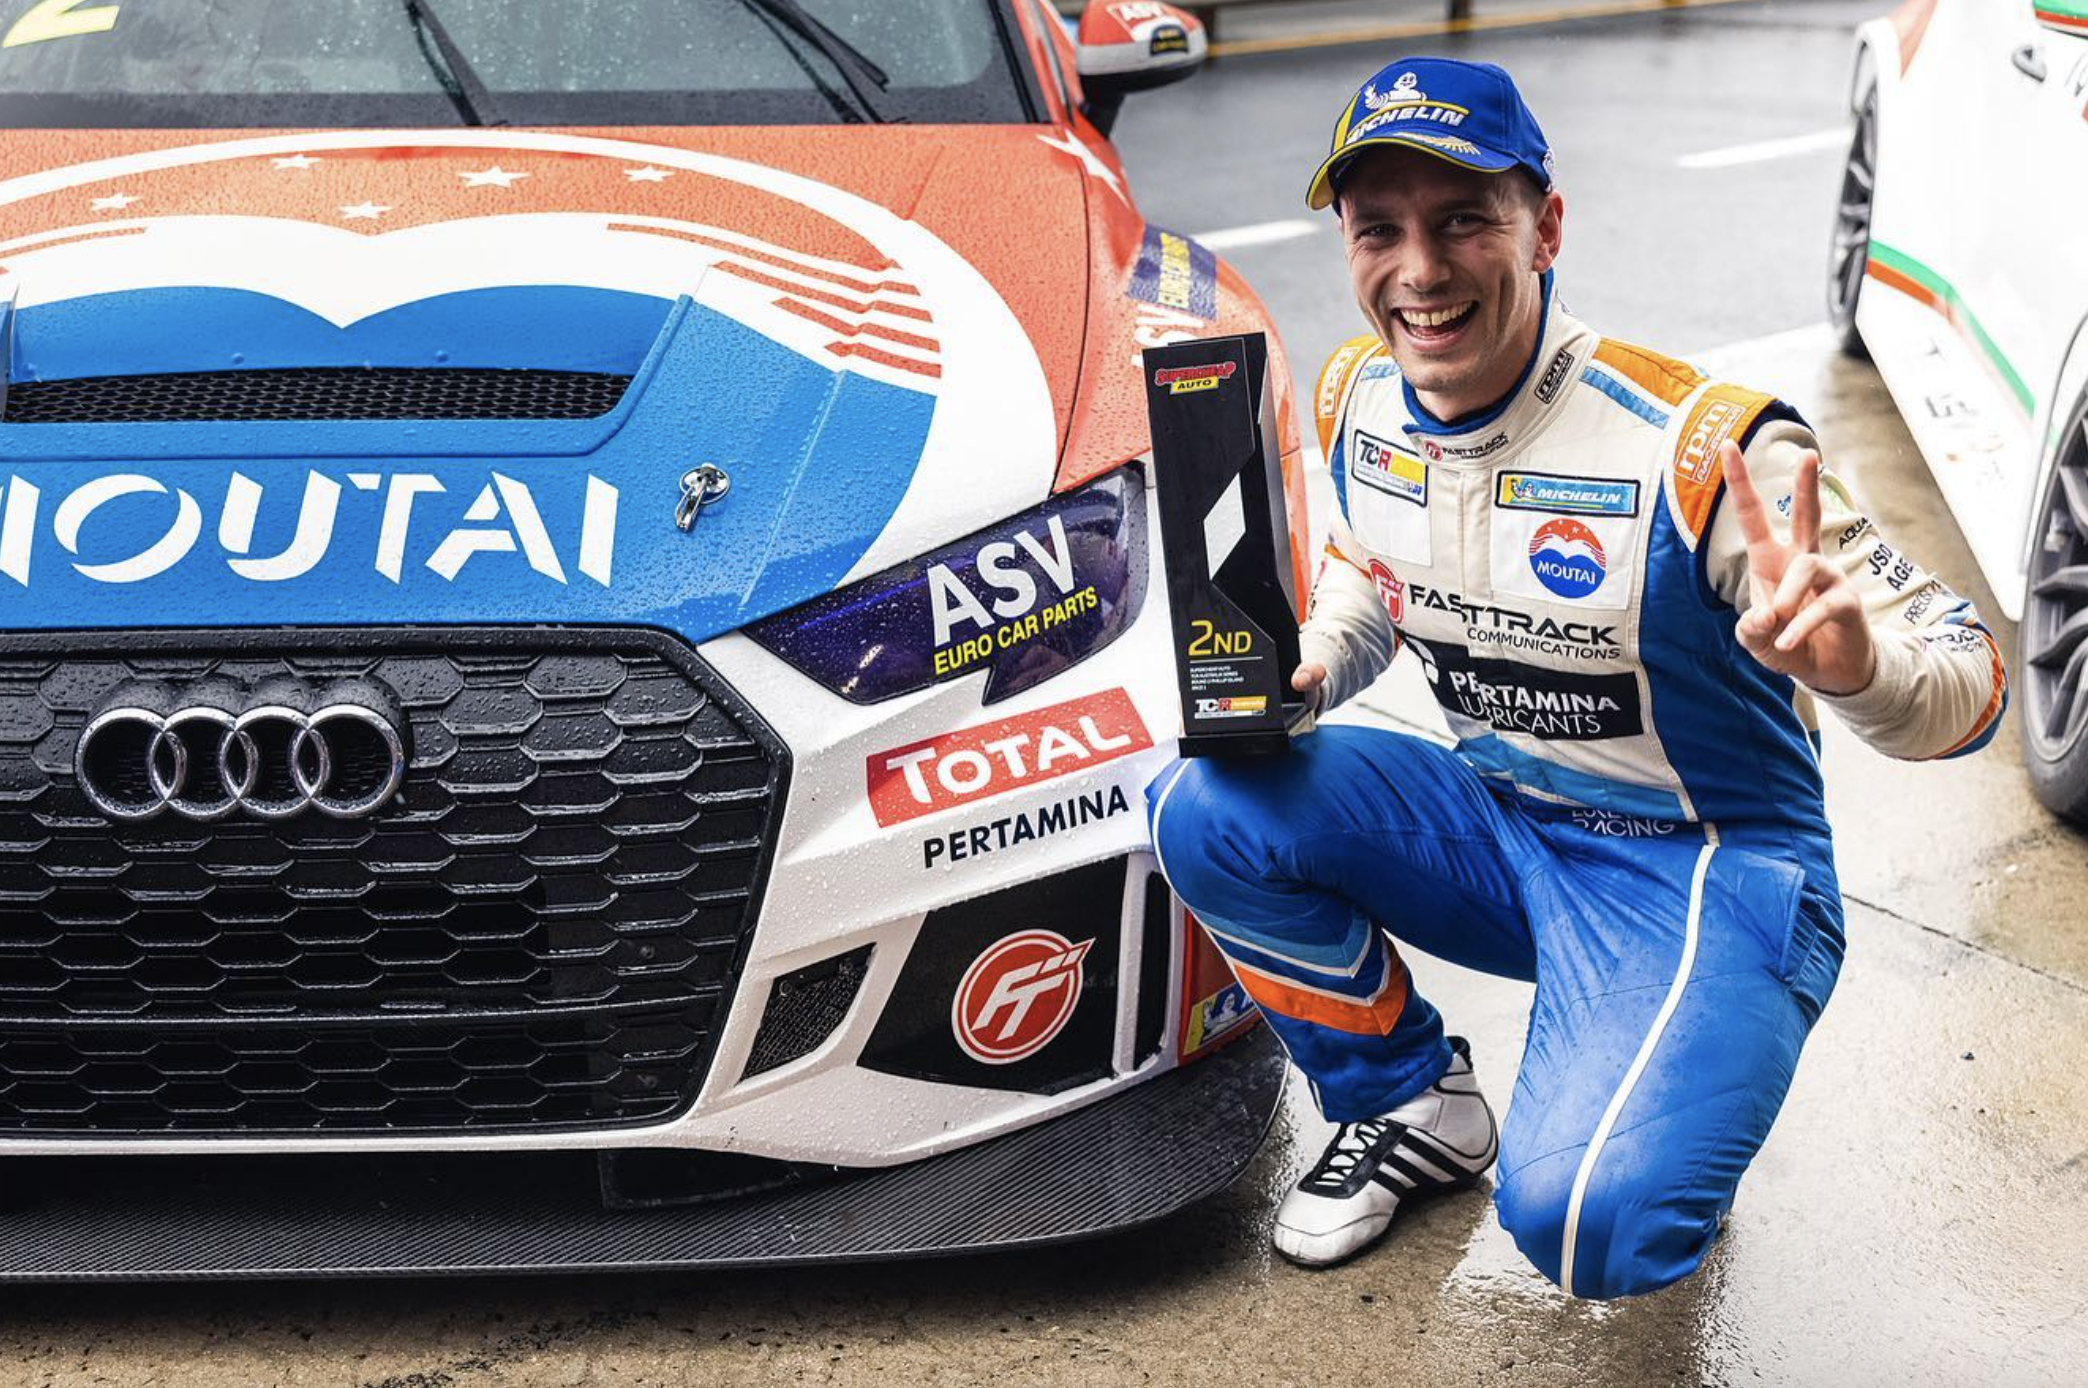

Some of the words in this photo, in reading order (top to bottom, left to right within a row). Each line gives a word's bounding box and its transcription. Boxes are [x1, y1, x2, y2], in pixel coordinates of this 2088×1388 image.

[1177, 378, 1213, 391] AUTO
[1359, 439, 1392, 473] TCR
[1680, 403, 1728, 472] rpm
[1536, 487, 1622, 504] MICHELIN
[927, 514, 1076, 648] ASV
[1537, 560, 1596, 586] MOUTAI
[934, 633, 994, 675] EURO
[997, 614, 1040, 649] CAR
[1042, 586, 1099, 630] PARTS
[1409, 583, 1618, 647] FASTTRACK
[1188, 619, 1253, 656] 2ND
[1467, 627, 1621, 660] COMMUNICATIONS
[1195, 697, 1232, 713] TCR
[1449, 670, 1621, 713] PERTAMINA
[886, 715, 1132, 805] TOTAL
[923, 784, 1131, 869] PERTAMINA
